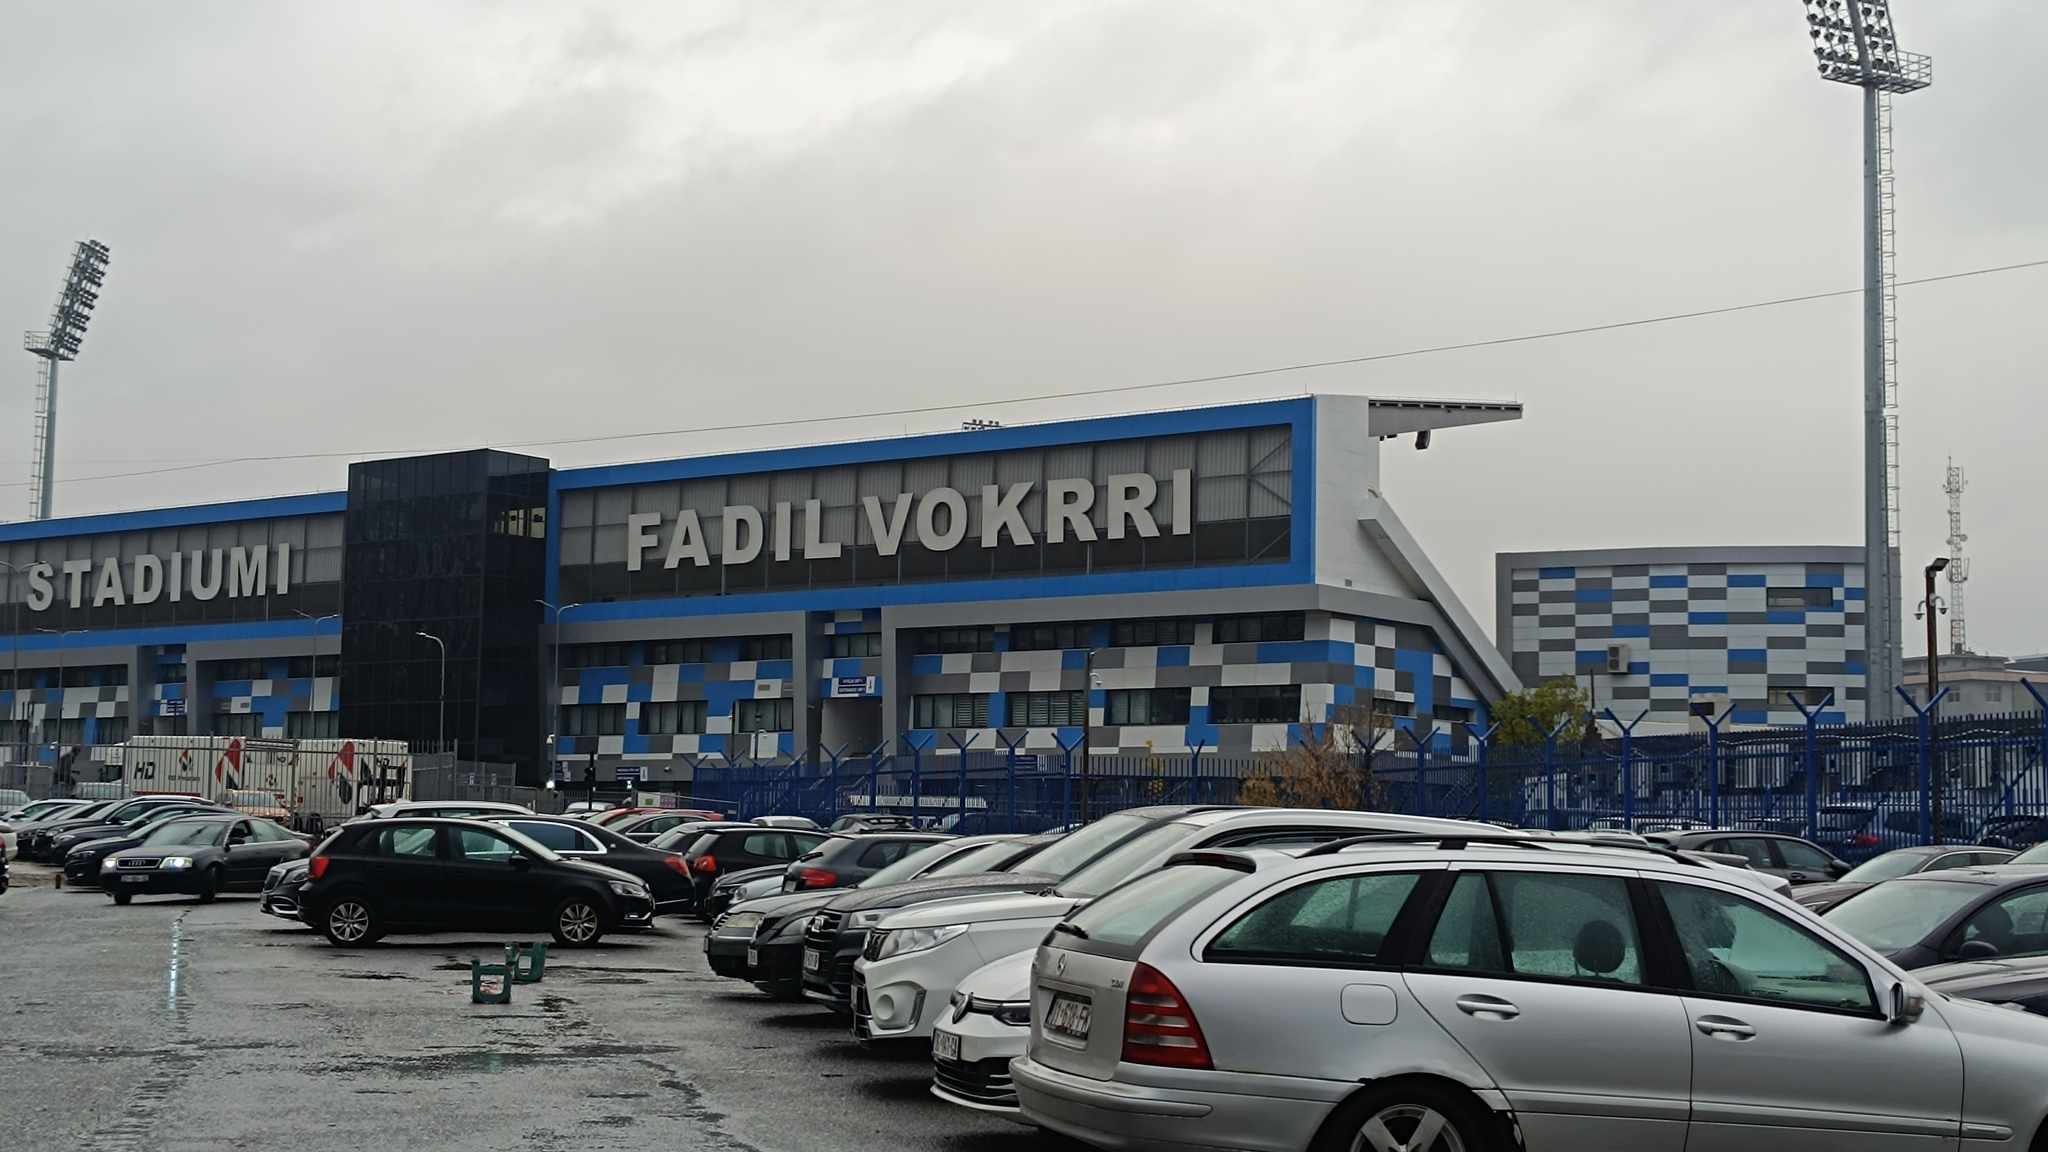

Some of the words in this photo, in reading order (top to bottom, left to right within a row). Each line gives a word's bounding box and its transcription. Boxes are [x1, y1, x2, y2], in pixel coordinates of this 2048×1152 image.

[627, 499, 842, 571] FADIL
[862, 469, 1192, 556] VOKRRI
[26, 542, 290, 611] STADIUMI
[134, 761, 156, 780] HD
